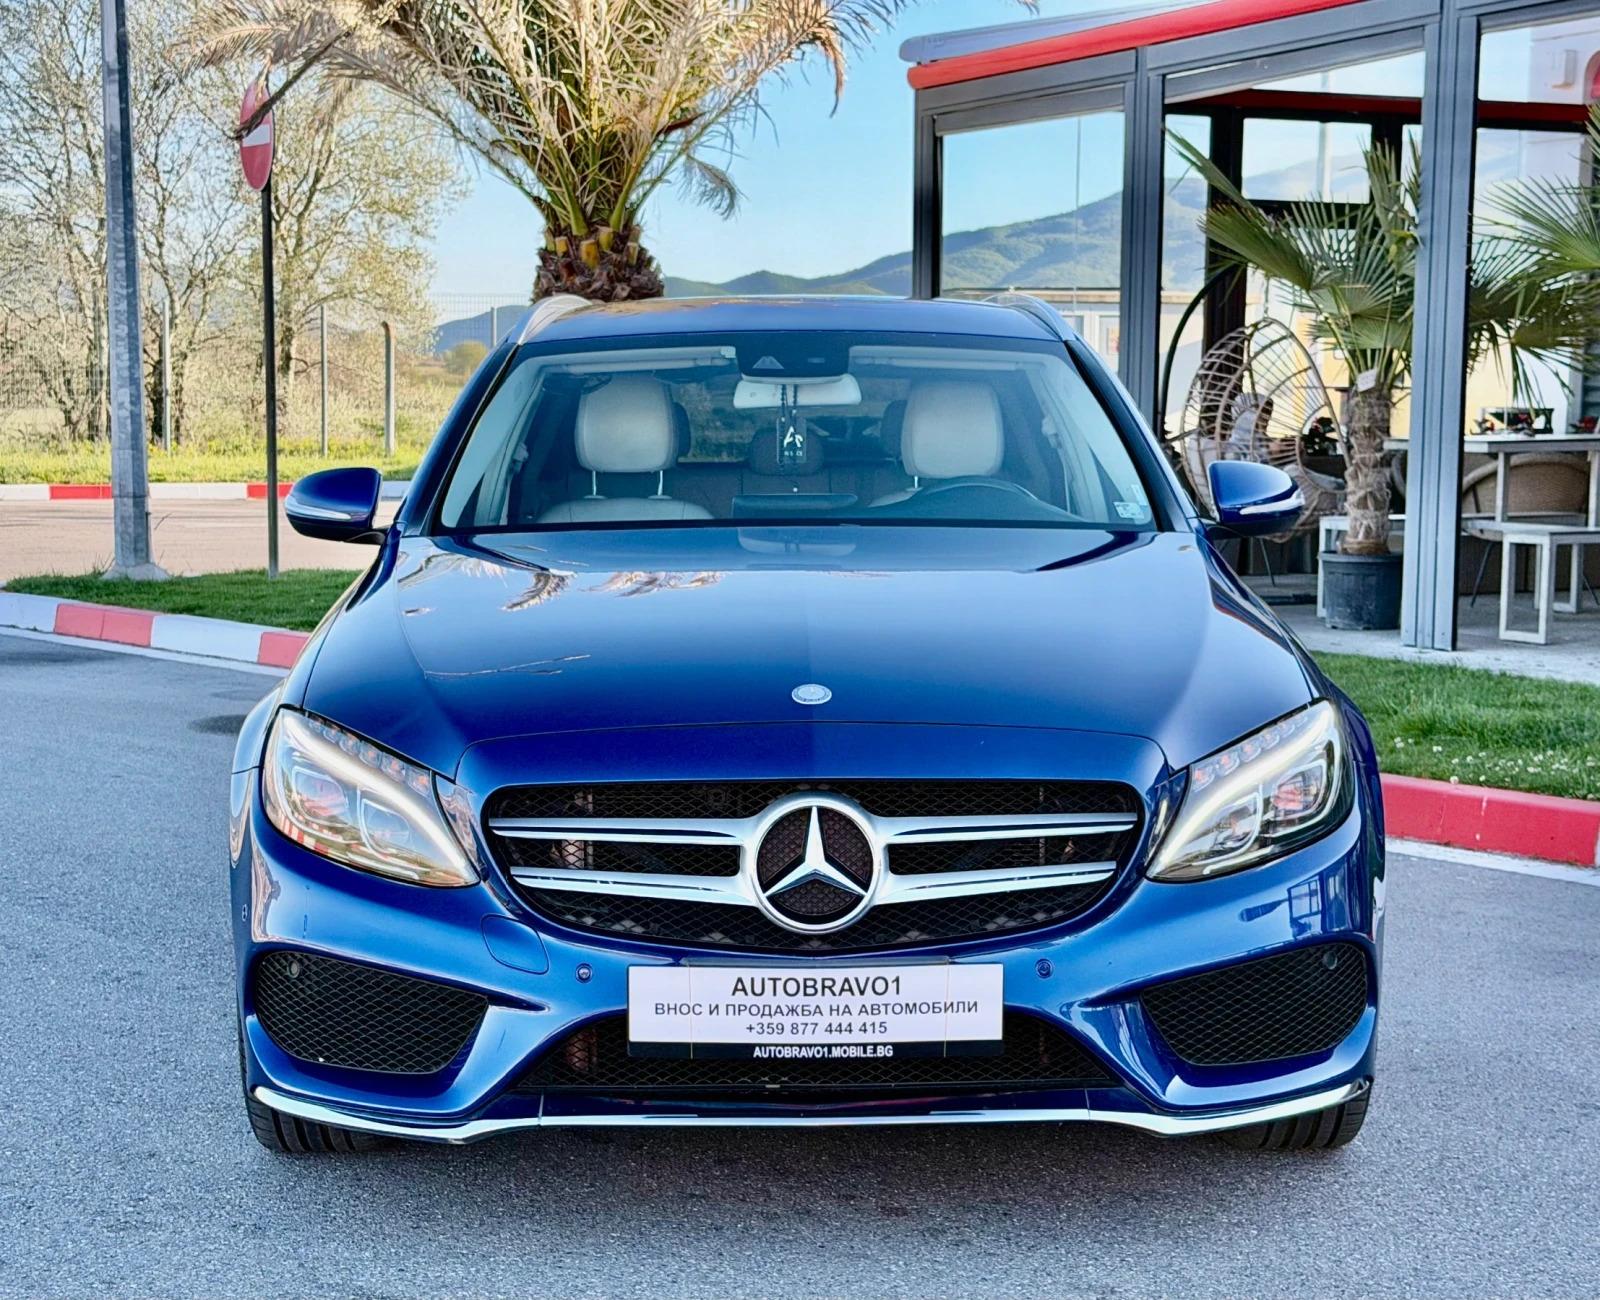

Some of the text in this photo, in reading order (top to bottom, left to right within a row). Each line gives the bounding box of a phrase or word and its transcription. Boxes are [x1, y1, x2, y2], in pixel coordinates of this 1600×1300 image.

[731, 976, 901, 997] AUTOBRAVO1
[654, 1001, 978, 1019] ВНОС И ПРОДАЖБА НА АВТОМОБИЛИ
[746, 1021, 887, 1036] +359 877 444 415
[753, 1045, 894, 1058] AUTOBRAVO1.MOBILE.BG
